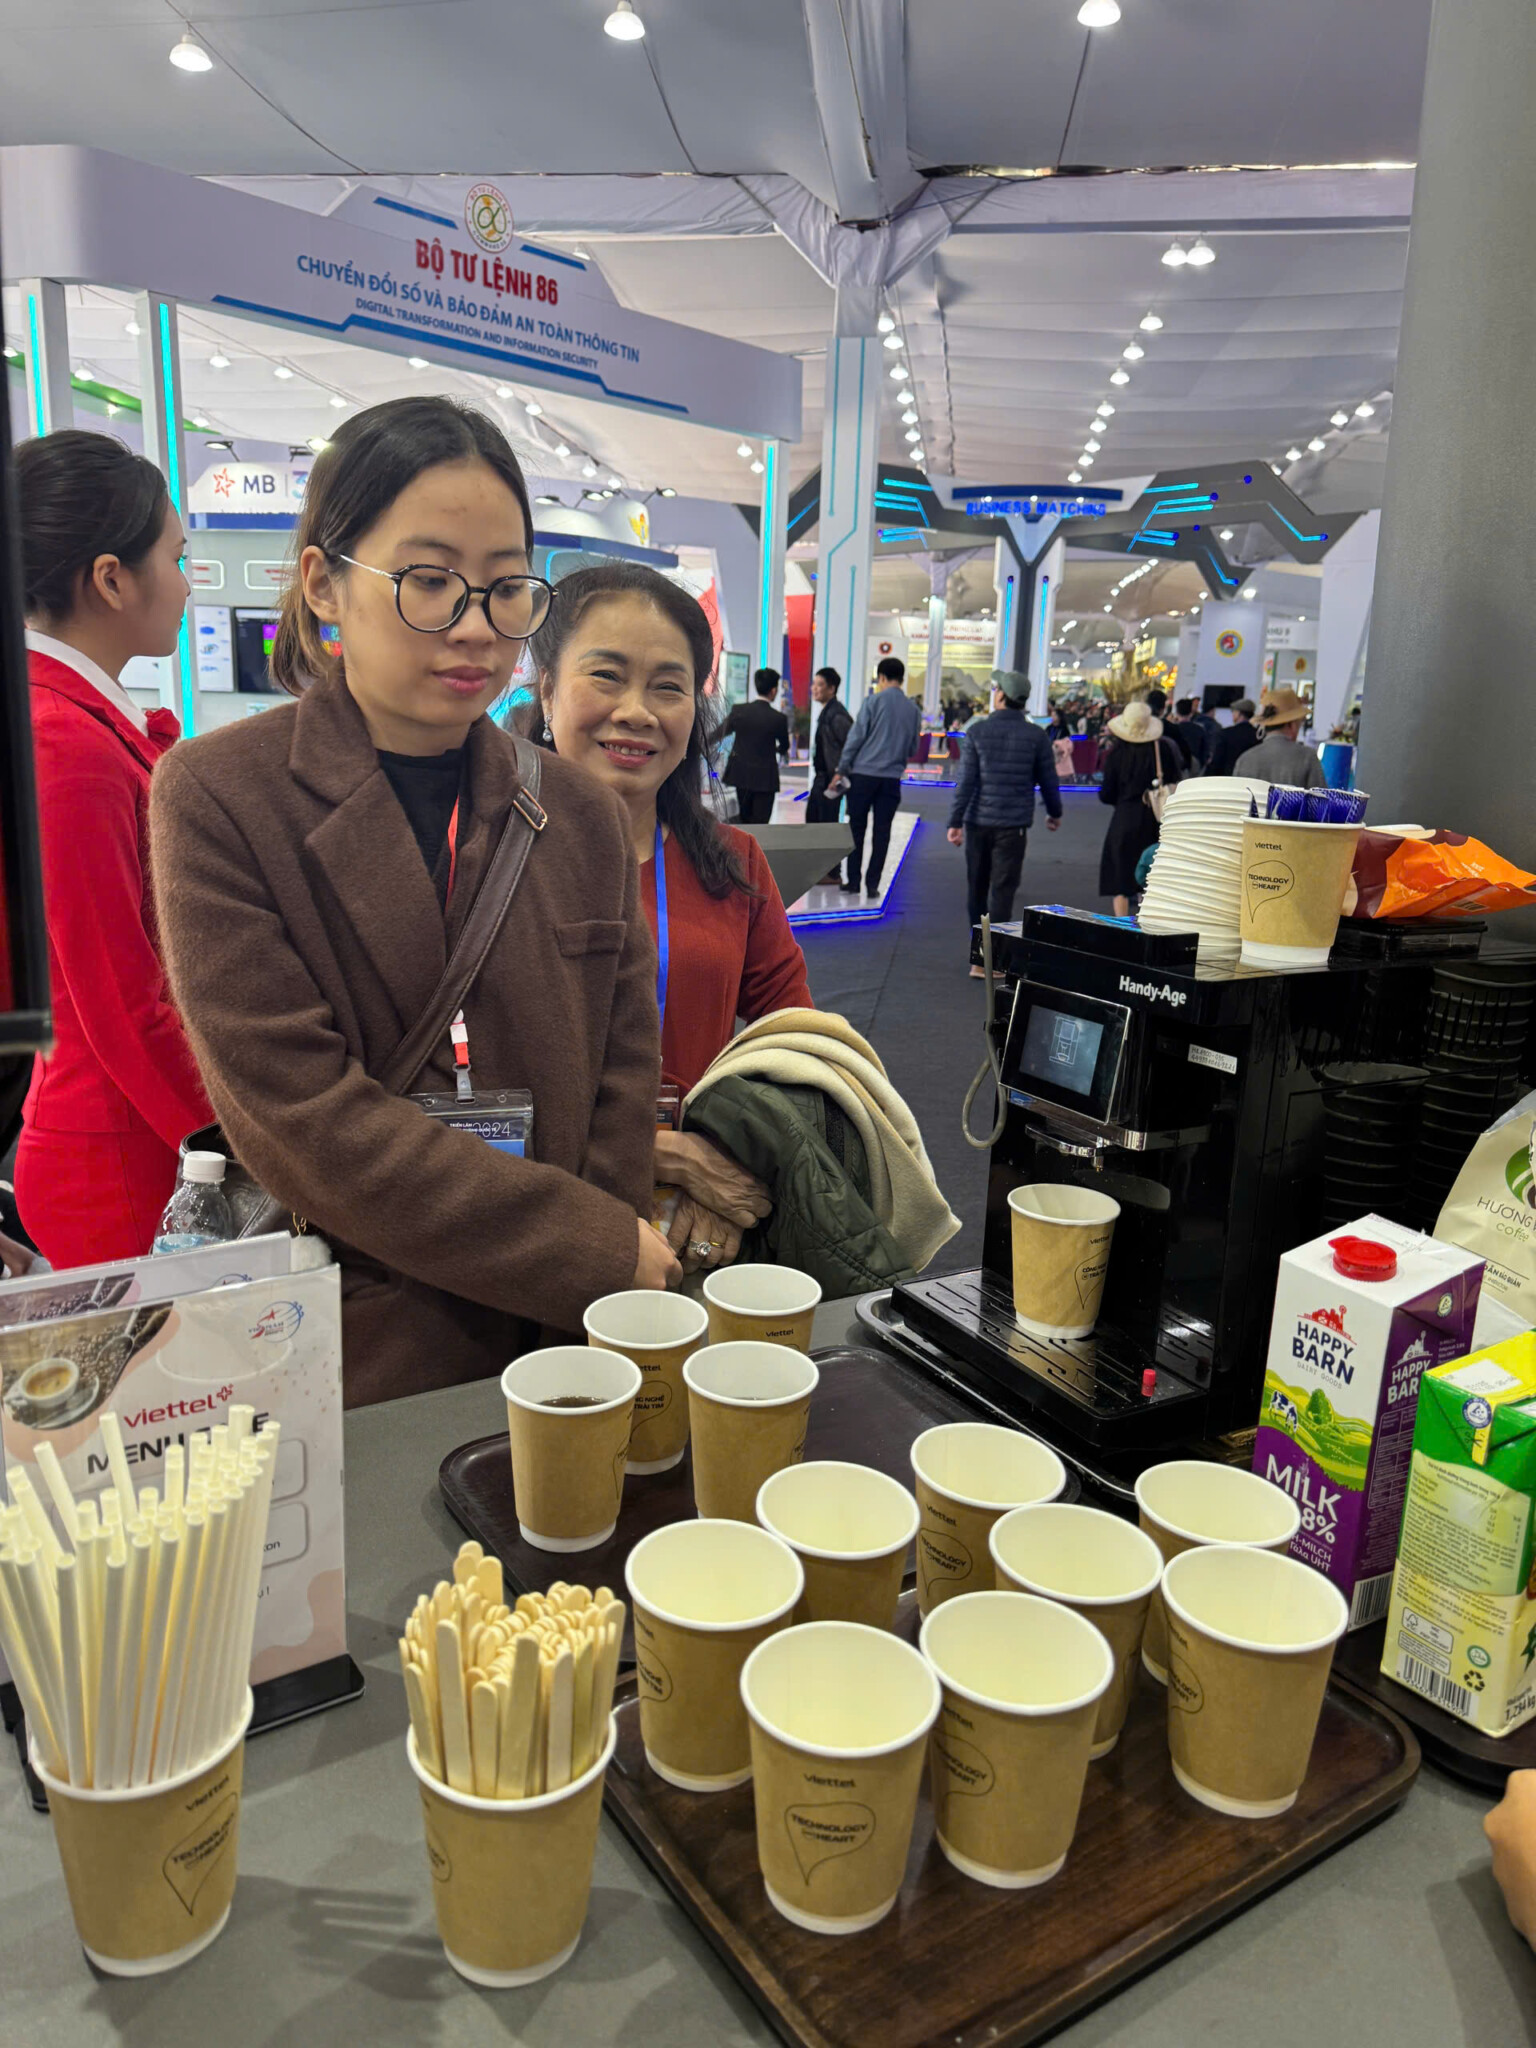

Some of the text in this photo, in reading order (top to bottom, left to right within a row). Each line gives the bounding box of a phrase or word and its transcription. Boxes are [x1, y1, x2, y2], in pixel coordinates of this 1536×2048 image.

[415, 237, 559, 306] BỘ TƯ LỆNH 86
[296, 255, 640, 363] CHUYỂN ĐỔI SỐ VÀ BẢO ĐẢM AN TOÀN THÔNG TIN
[356, 297, 599, 370] DIGITAL TRANSFORMATION AND INFORMATION SECURITY
[243, 474, 275, 494] MB
[966, 500, 1106, 517] BUSINESS MATCHING
[1254, 842, 1283, 851] viettel
[1248, 873, 1289, 885] TECHNOLOGY
[1258, 882, 1281, 891] HEART
[1119, 975, 1187, 1007] Handy-Age
[1476, 1196, 1533, 1228] HƯƠNG
[1496, 1221, 1530, 1243] coffee
[1297, 1320, 1354, 1360] HAPPY
[639, 1364, 661, 1372] ettel
[1292, 1336, 1355, 1385] BARN
[1391, 1359, 1431, 1385] HAPPY
[1297, 1361, 1343, 1389] DAIRY GOODS
[1387, 1376, 1419, 1405] BAR
[123, 1394, 217, 1428] viettel
[1265, 1453, 1342, 1523] MILK
[1301, 1507, 1336, 1544] 8%
[1291, 1534, 1332, 1563] H-MILCH
[1310, 1553, 1331, 1573] UHT
[803, 1773, 856, 1788] viettel
[791, 1813, 868, 1833] TECHNOLOGY
[815, 1833, 856, 1843] HEART
